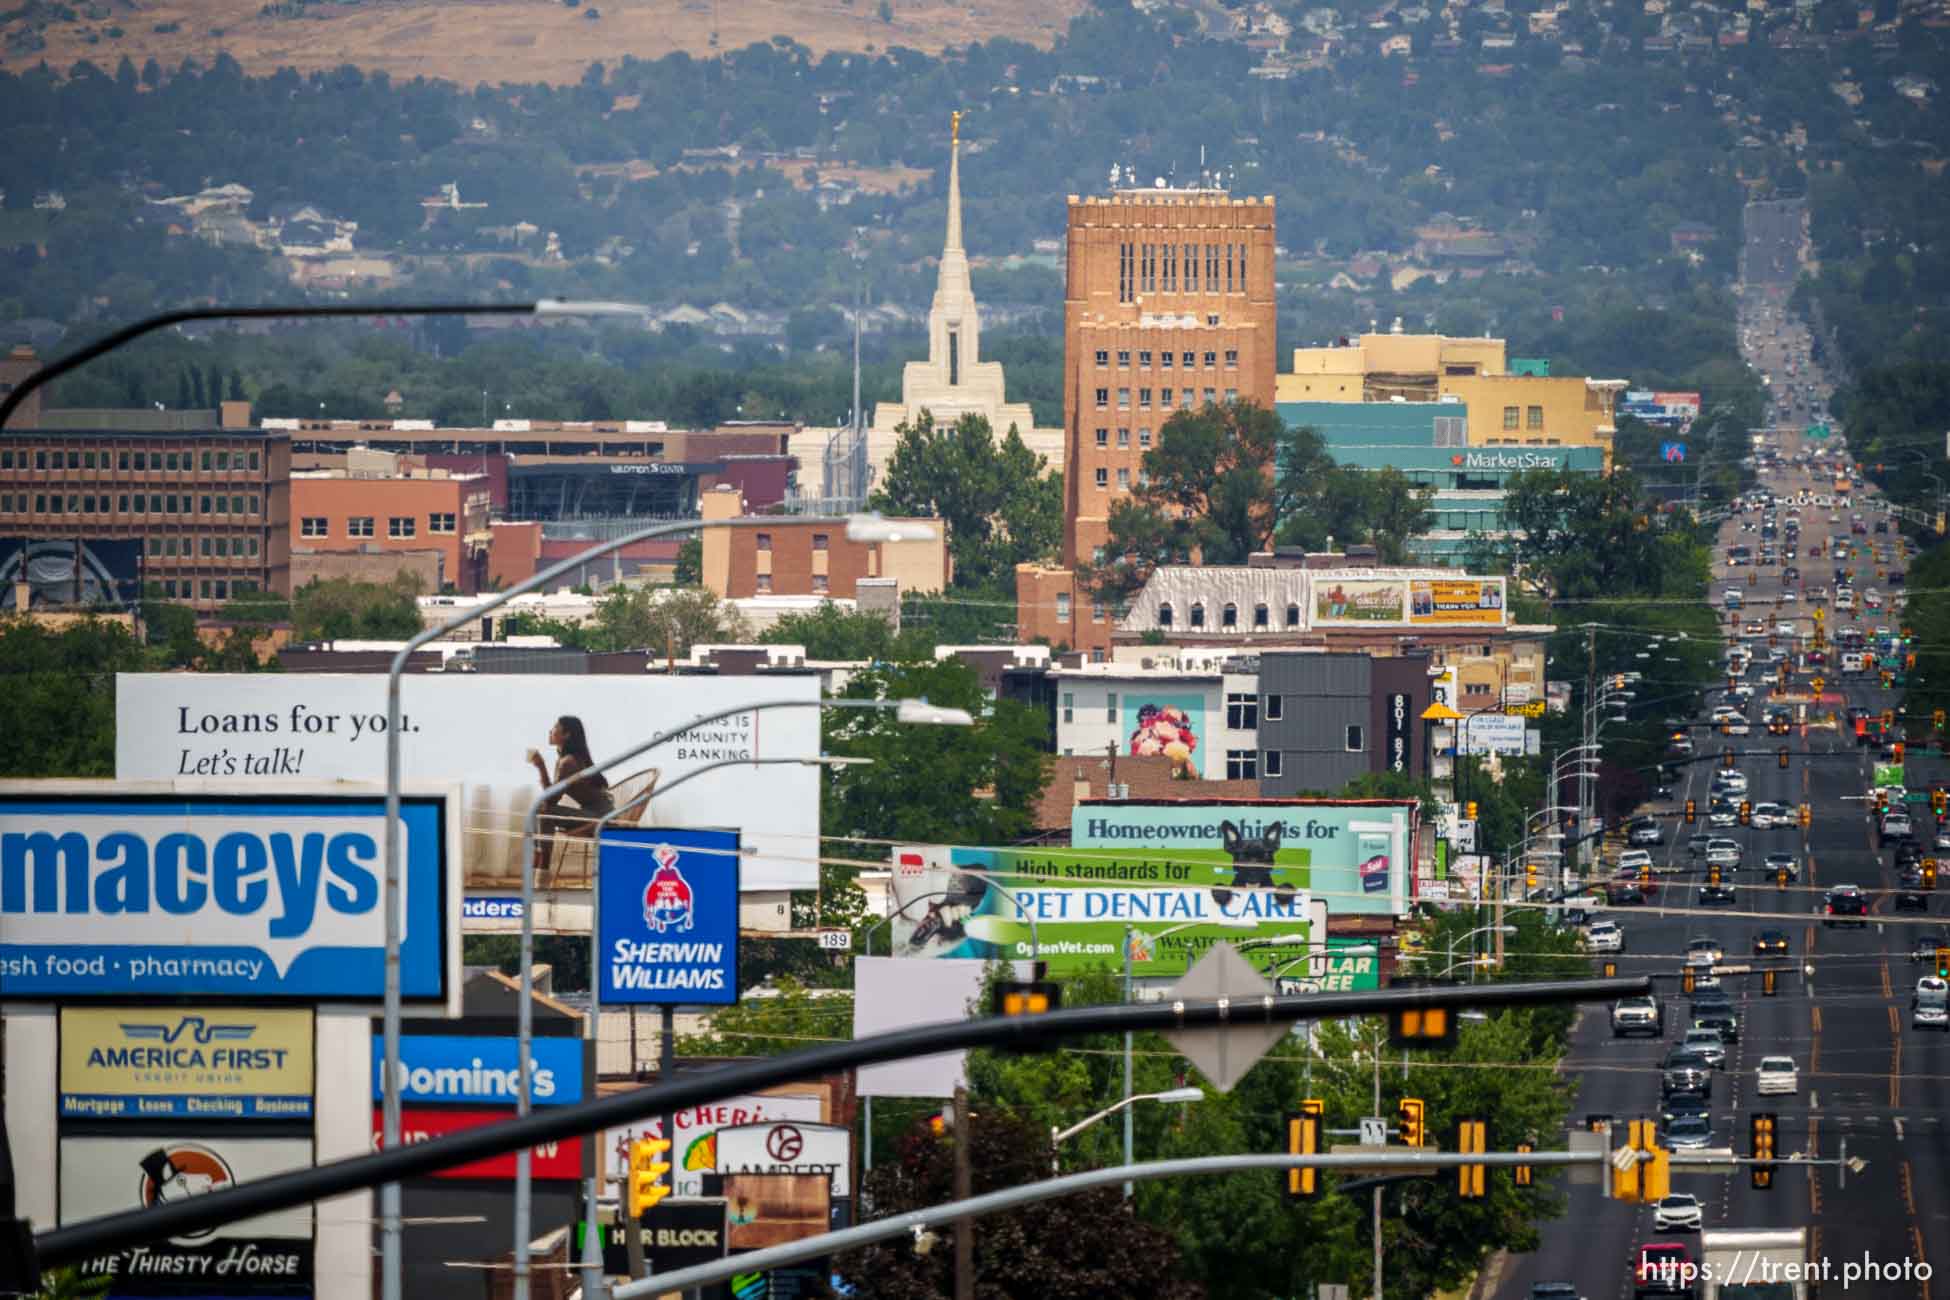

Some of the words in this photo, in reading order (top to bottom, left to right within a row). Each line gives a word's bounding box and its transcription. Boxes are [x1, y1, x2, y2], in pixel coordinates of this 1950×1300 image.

[1467, 452, 1557, 469] MarketStar
[177, 706, 279, 733] Loans
[290, 705, 340, 733] for
[736, 716, 749, 727] IS
[245, 749, 304, 775] talk!
[677, 748, 749, 760] BANKING
[1281, 820, 1300, 839] is
[1306, 819, 1340, 839] for
[1016, 860, 1058, 884] High
[1064, 860, 1158, 880] standards
[1165, 860, 1191, 879] for
[1, 831, 379, 939] maceys
[777, 904, 785, 916] 8
[1015, 892, 1074, 918] PET
[1084, 892, 1208, 919] DENTAL
[1220, 891, 1303, 918] CARE
[613, 939, 723, 963] SHERWIN
[822, 934, 847, 947] 189
[46, 955, 105, 976] food
[130, 955, 263, 981] pharmacy
[612, 965, 725, 990] WILLIAMS
[87, 1047, 206, 1069] AMERICA
[212, 1048, 288, 1070] FIRST
[64, 1098, 126, 1115] Mortgage
[138, 1098, 174, 1113] Loans
[187, 1098, 243, 1115] Checking
[256, 1098, 310, 1113] Business
[612, 1229, 653, 1245] HR
[658, 1229, 718, 1246] BLOCK
[122, 1247, 213, 1274] THIRSTY
[216, 1244, 299, 1274] HORSE
